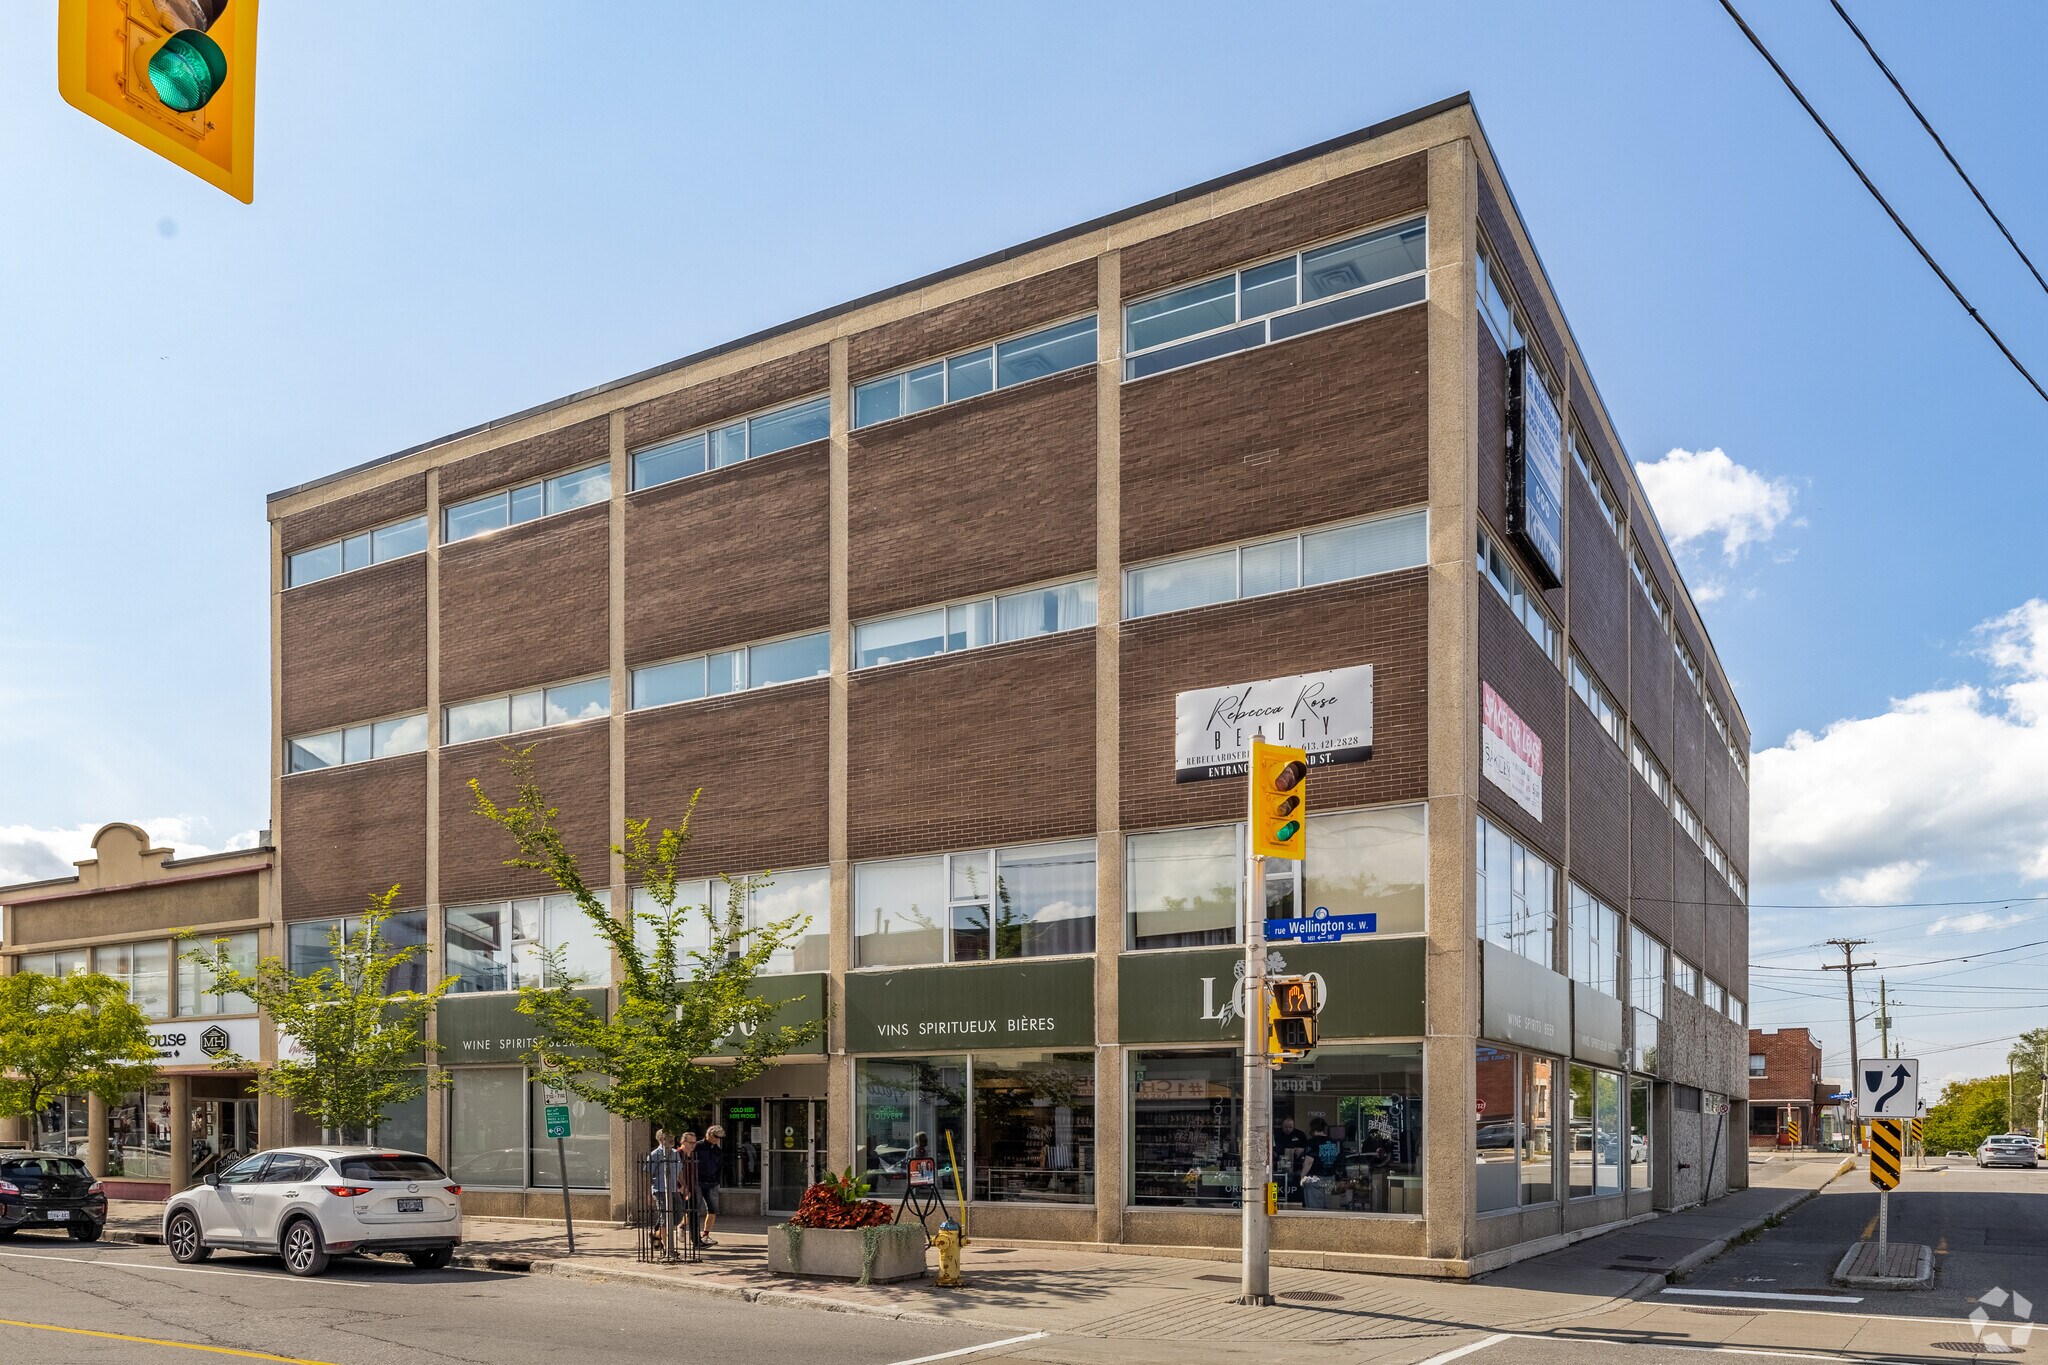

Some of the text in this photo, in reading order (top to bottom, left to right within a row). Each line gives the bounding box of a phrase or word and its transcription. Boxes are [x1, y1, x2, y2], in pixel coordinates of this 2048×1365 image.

[1206, 682, 1338, 731] Rebecca Rose
[1208, 763, 1250, 777] ENTRANC
[1289, 920, 1345, 935] Wellington
[1347, 921, 1356, 930] St.
[1358, 921, 1369, 929] W.
[877, 1015, 1055, 1036] VINS SPIRITUEUX BIÈRES
[1507, 1013, 1522, 1028] WINE
[462, 1039, 491, 1050] WINE
[499, 1037, 538, 1050] SPIRITS
[879, 1105, 899, 1113] OPEN
